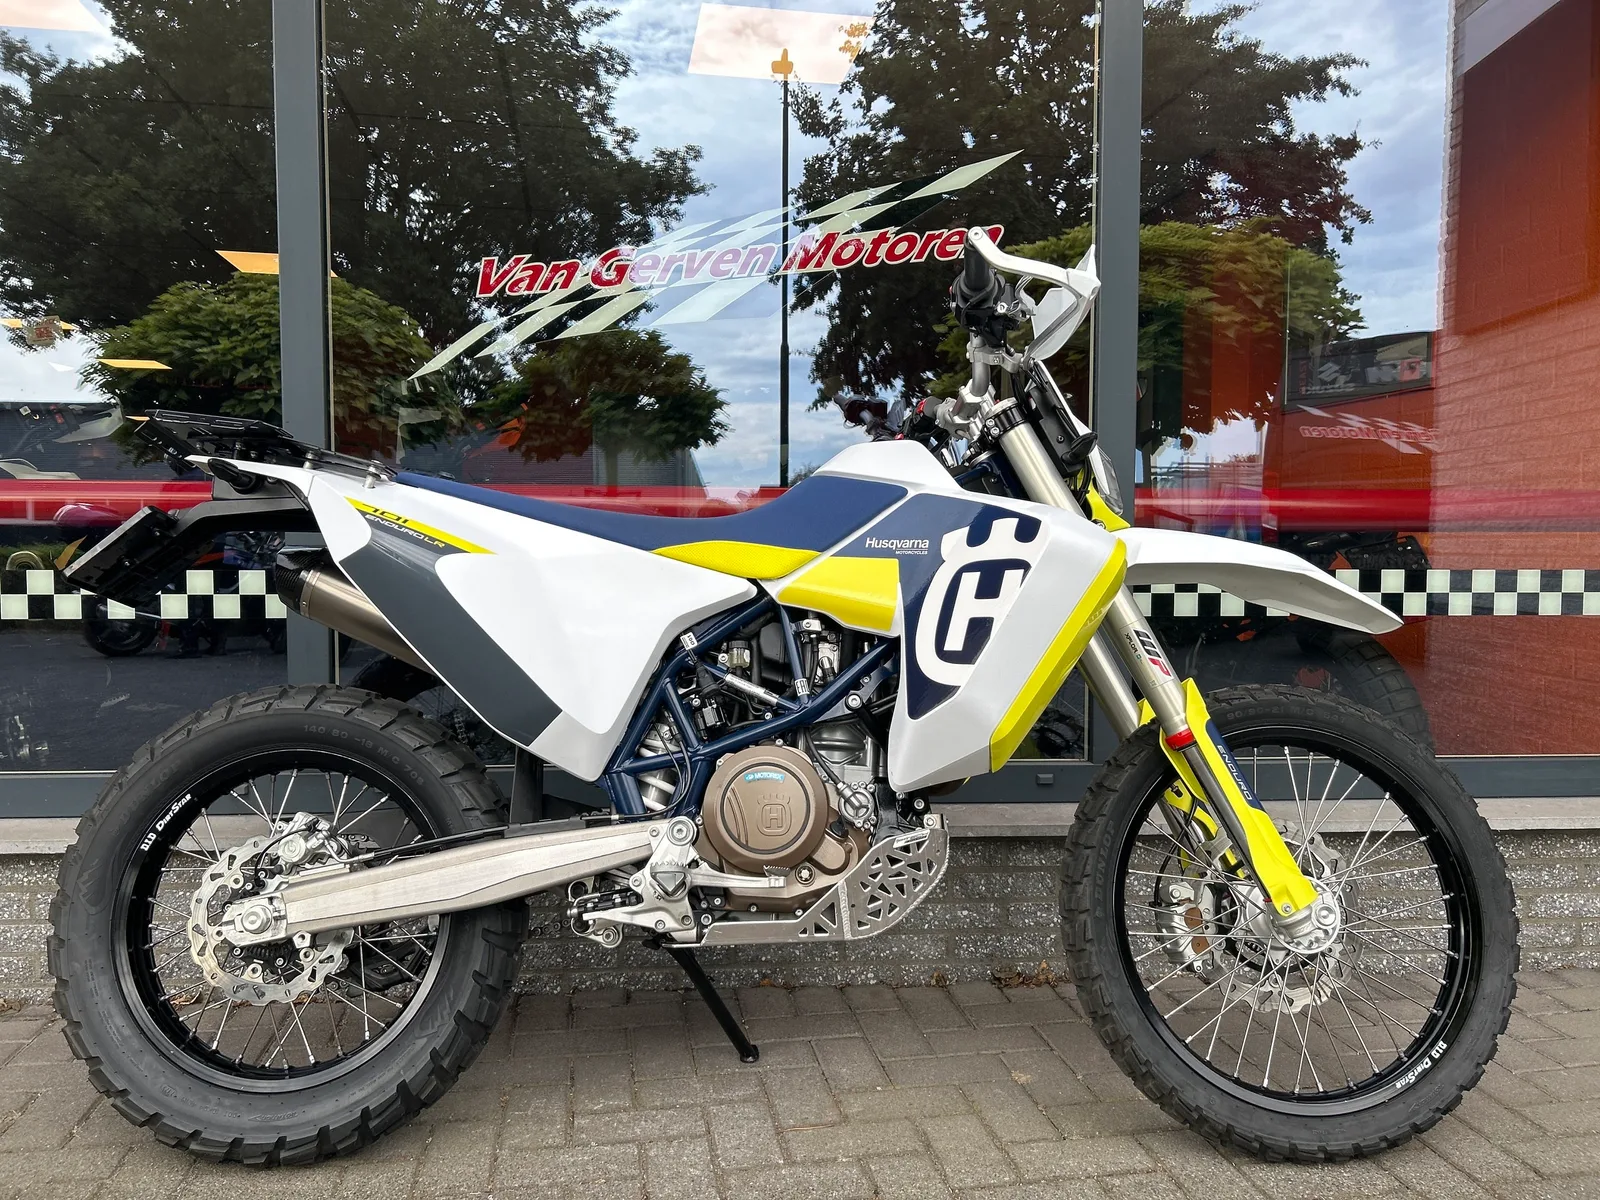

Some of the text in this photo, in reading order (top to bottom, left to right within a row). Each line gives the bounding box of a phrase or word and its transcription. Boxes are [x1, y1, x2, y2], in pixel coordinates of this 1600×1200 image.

[475, 253, 581, 297] Van
[590, 243, 777, 289] Gerven
[362, 503, 409, 524] 701
[364, 514, 446, 549] ENDURO LR
[865, 537, 930, 550] Husqvarna
[1132, 629, 1172, 677] WP
[302, 724, 350, 740] 140/80
[376, 745, 401, 766] M/C
[1217, 744, 1253, 800] ENDURO
